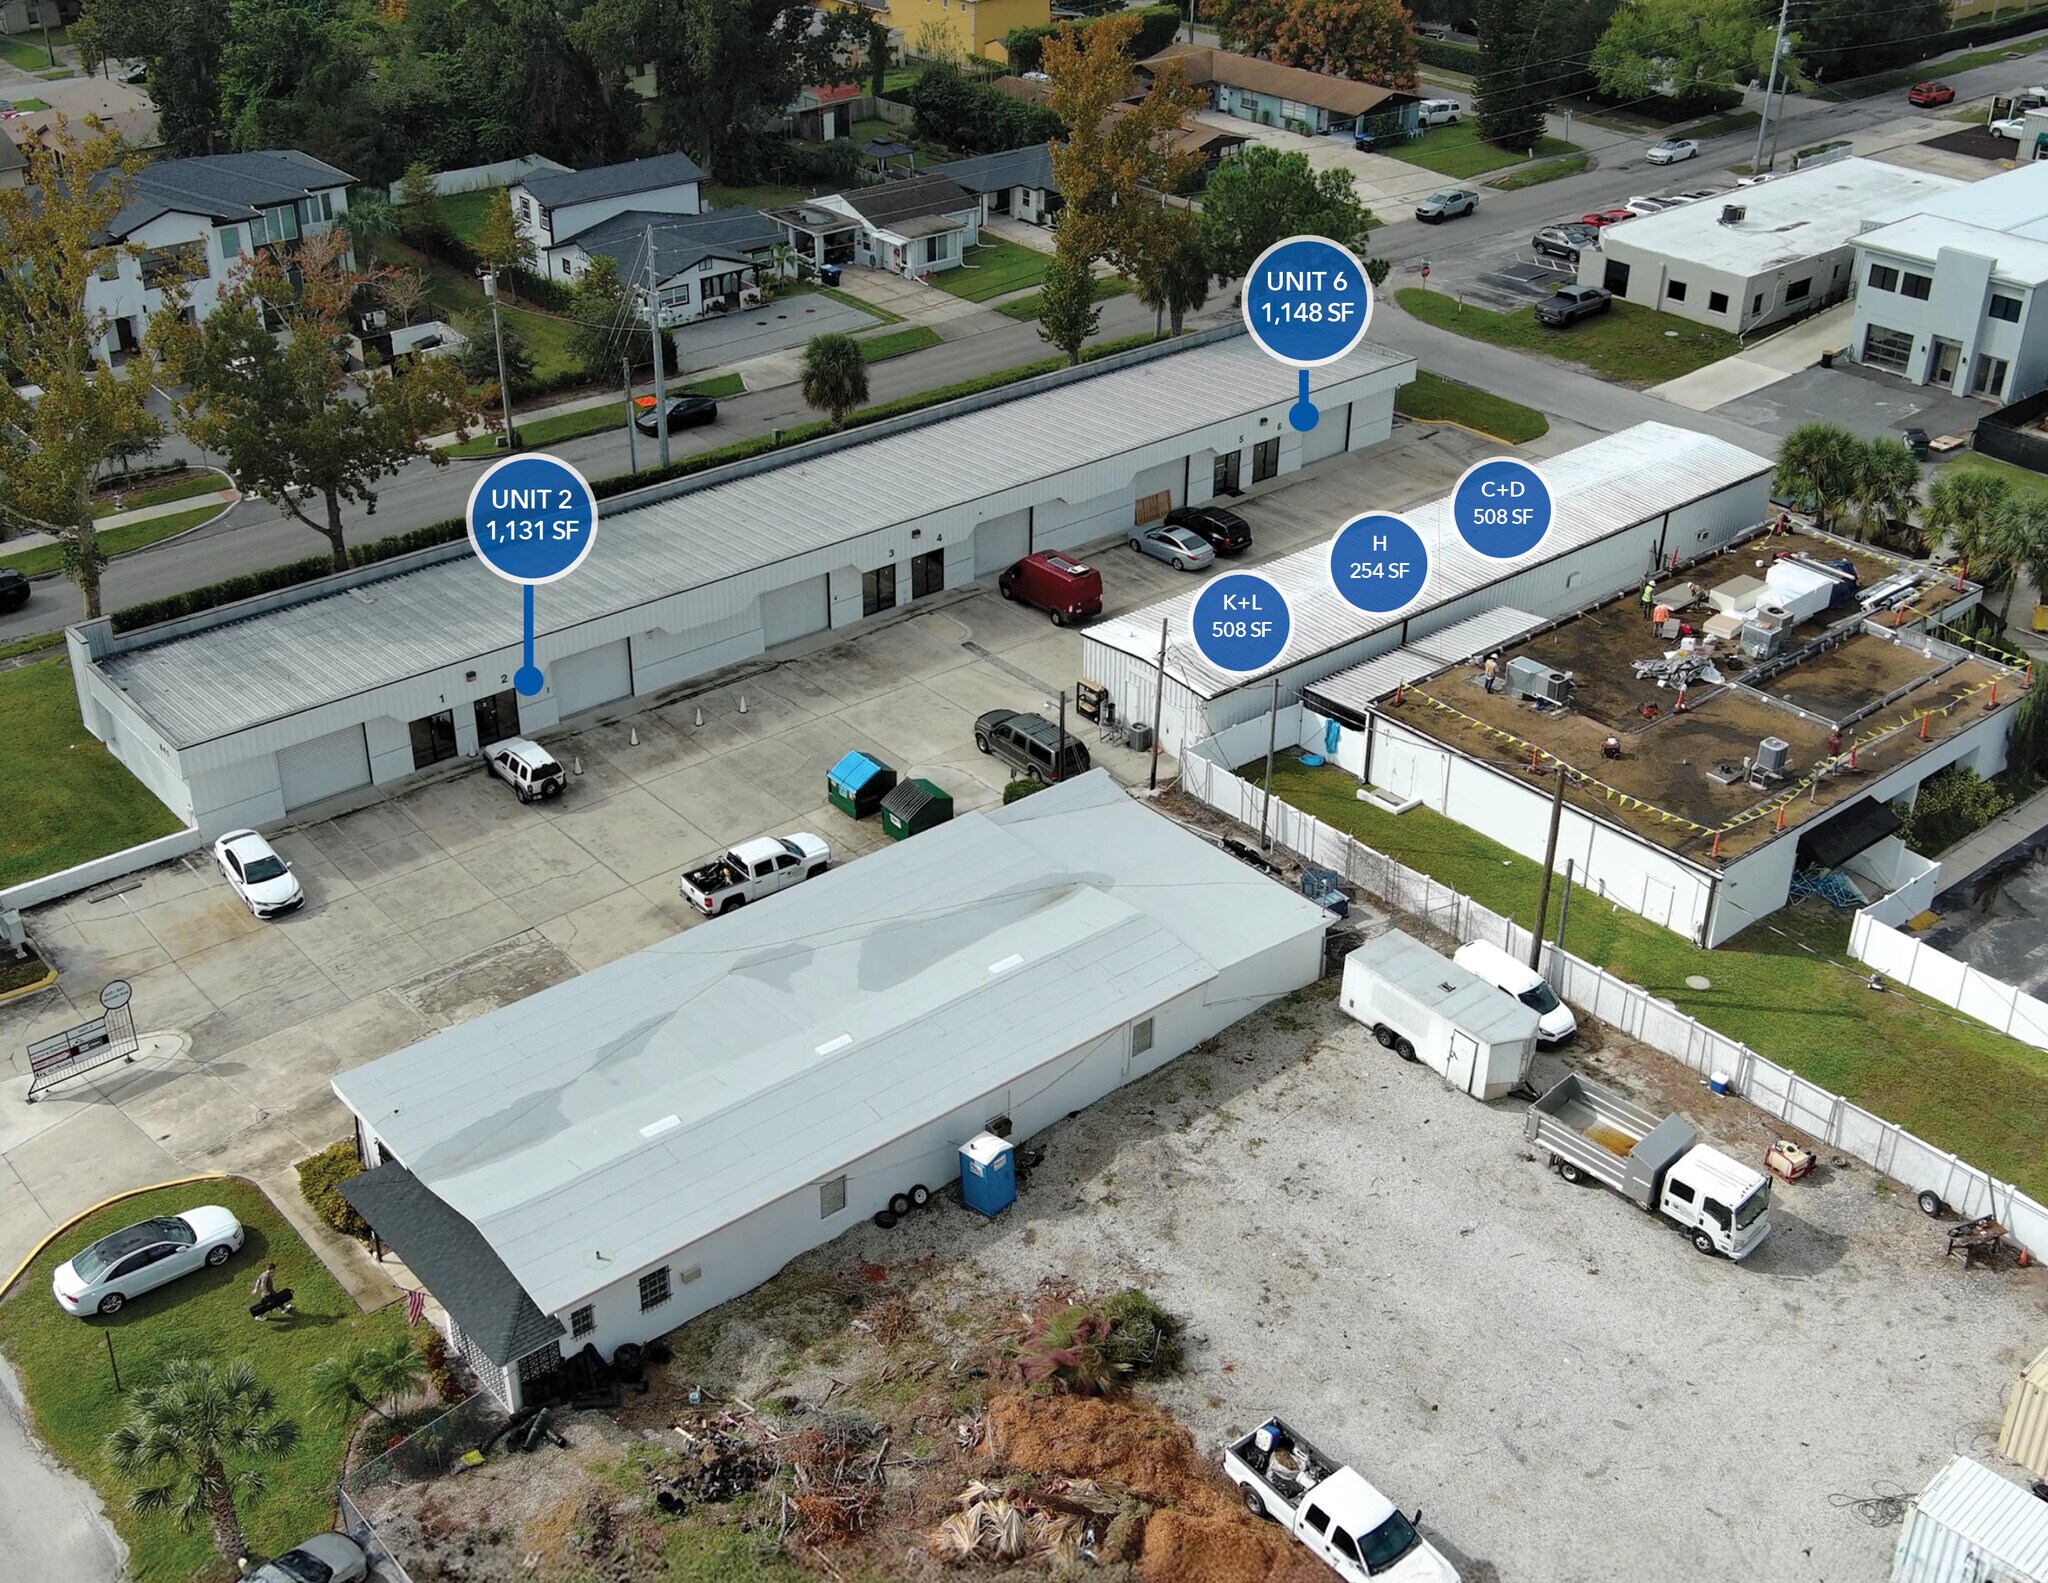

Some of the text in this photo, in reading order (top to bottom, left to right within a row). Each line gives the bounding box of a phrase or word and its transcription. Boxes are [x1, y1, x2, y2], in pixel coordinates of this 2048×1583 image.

[1276, 422, 1282, 431] 6
[1238, 434, 1244, 443] 5
[936, 533, 942, 542] 4
[889, 549, 895, 558] 3
[500, 673, 508, 684] 2
[438, 693, 445, 703] 1
